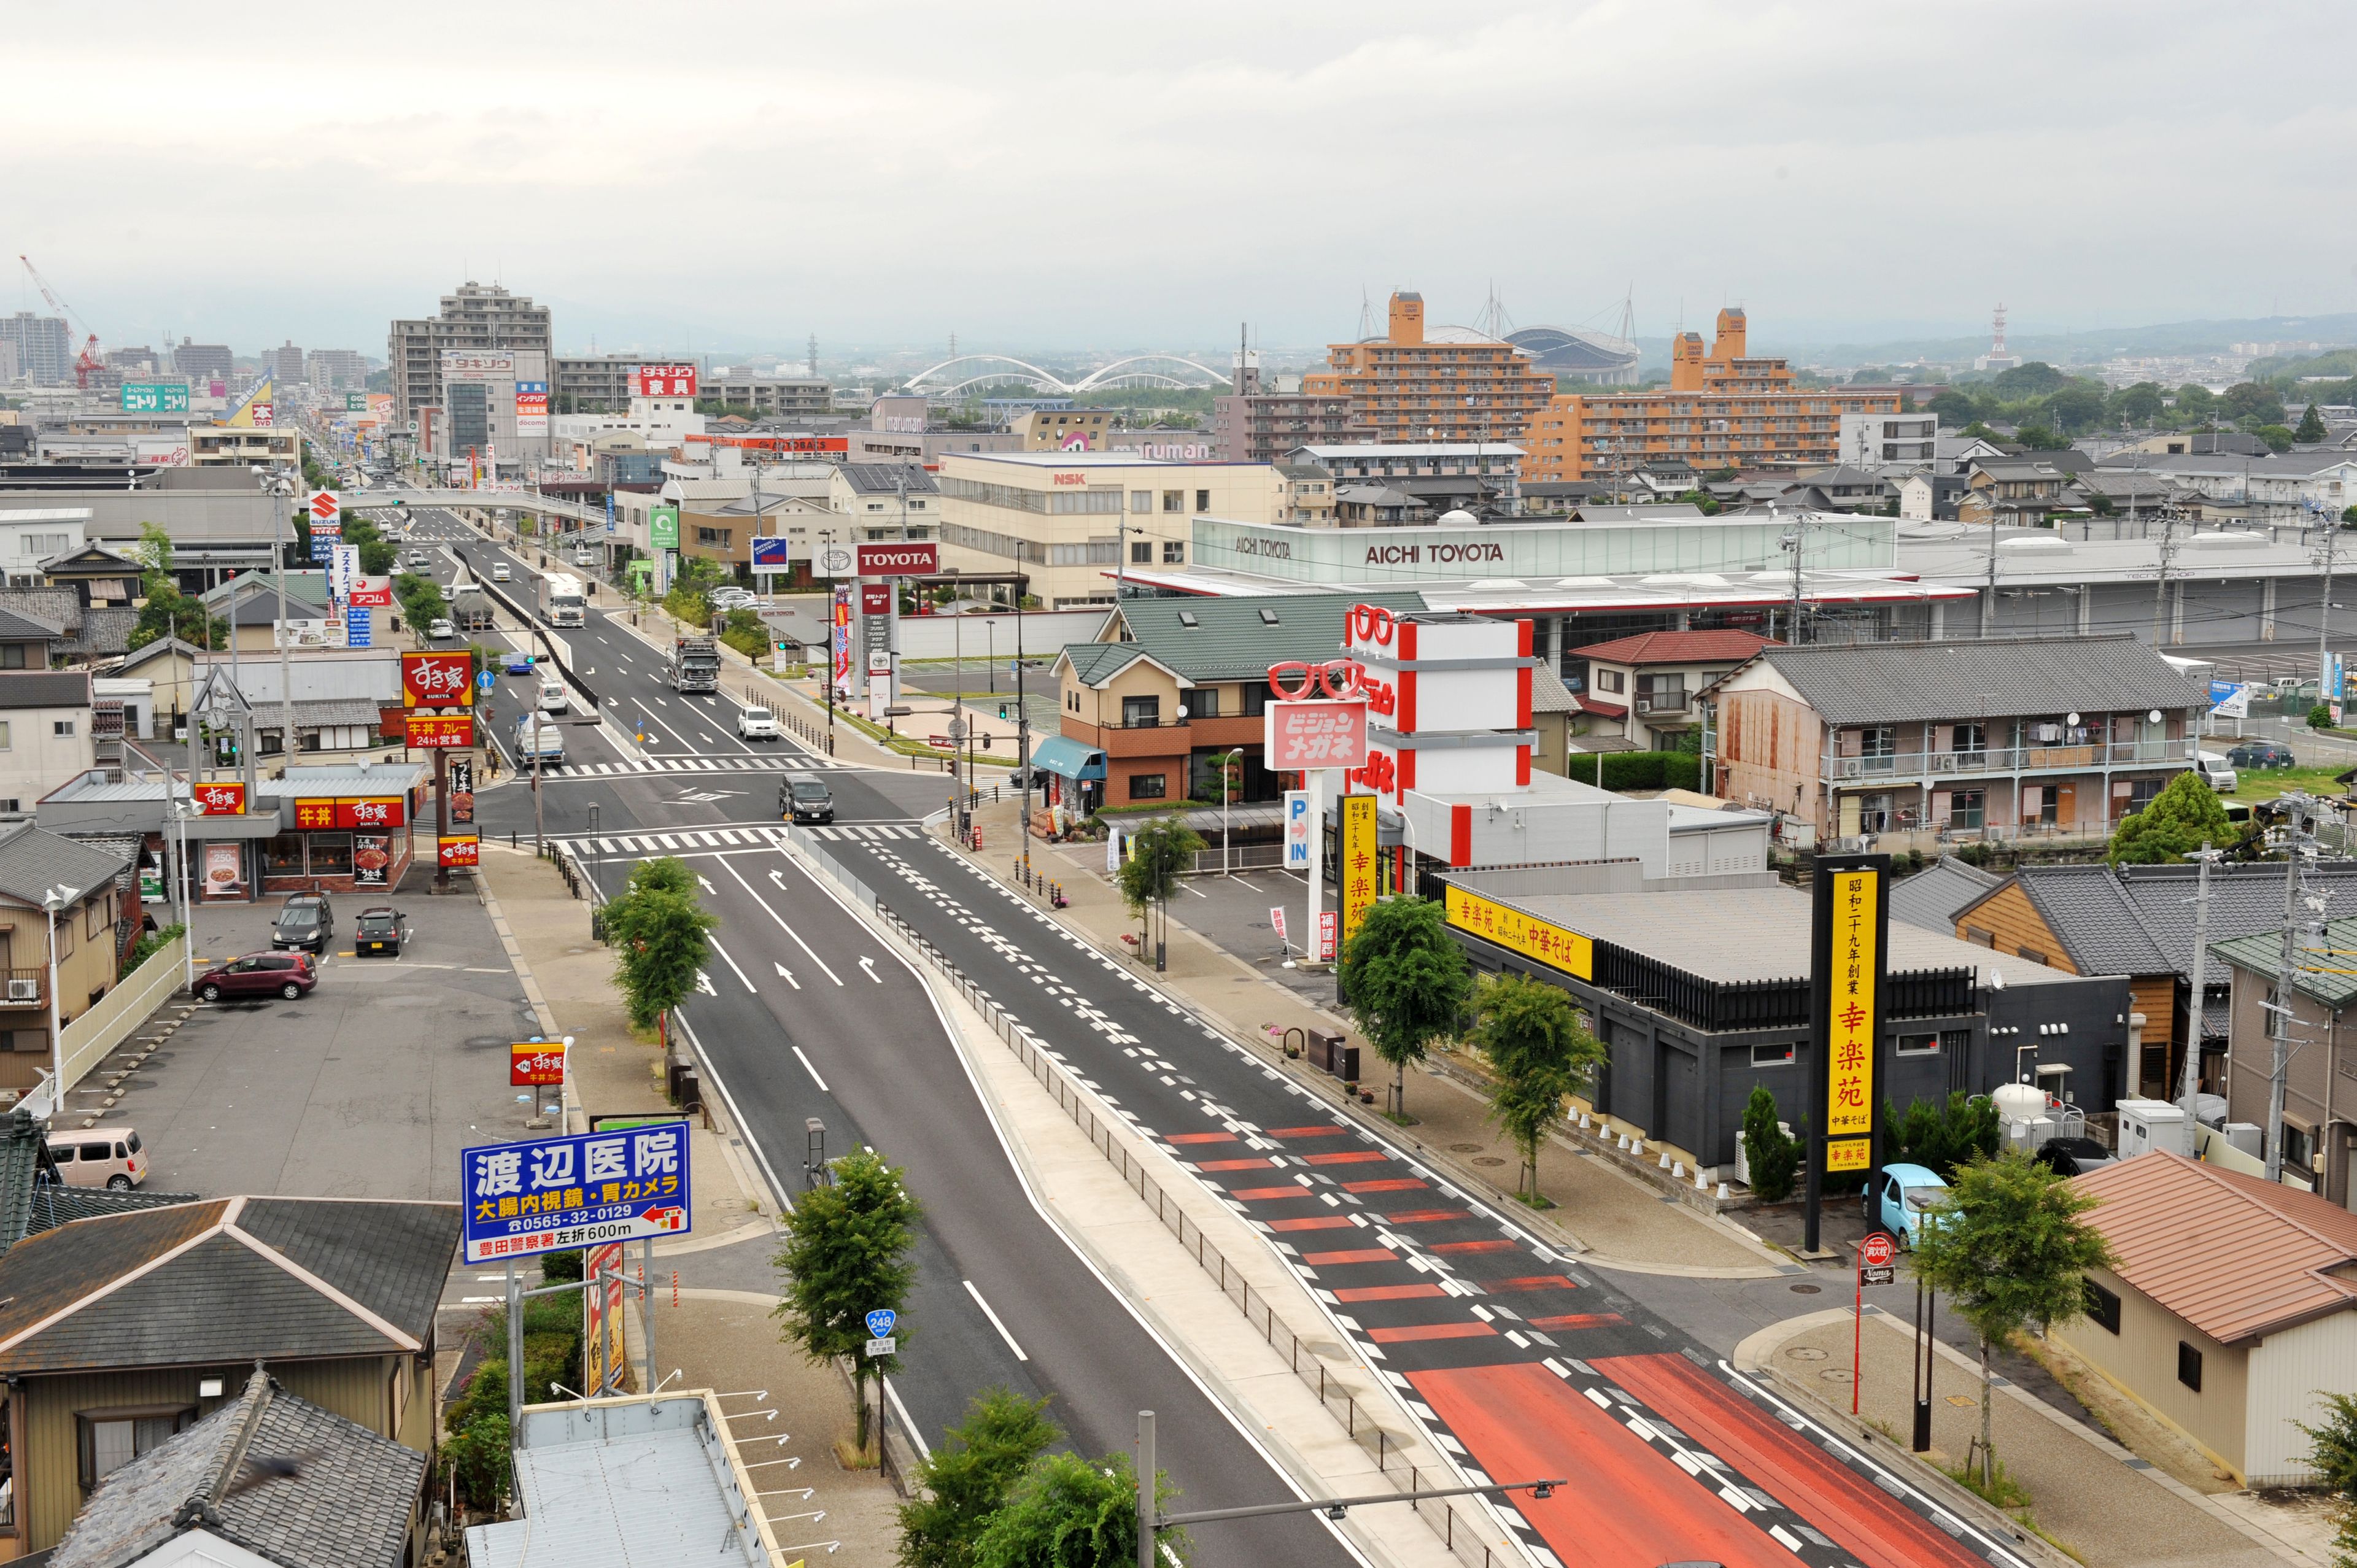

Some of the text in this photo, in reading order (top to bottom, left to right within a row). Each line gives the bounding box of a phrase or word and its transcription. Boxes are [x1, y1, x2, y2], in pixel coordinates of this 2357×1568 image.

[643, 367, 693, 377] タキソウ
[649, 379, 689, 395] 家具
[126, 395, 187, 409] ニトリ ニトリ
[253, 406, 272, 419] 本
[886, 414, 923, 433] maruman
[1054, 474, 1086, 485] NSK
[1236, 536, 1291, 560] AICHI TOYOTA
[1366, 544, 1503, 565] AICHI TOYOTA
[861, 553, 932, 566] TOYOTA
[356, 594, 384, 604] アコム
[411, 658, 465, 693] すき家
[409, 722, 469, 735] 牛丼 カレー
[1285, 713, 1354, 734] ビジョン
[1285, 735, 1354, 760] メガネ
[204, 787, 236, 806] すき家
[300, 807, 331, 825] 牛丼
[352, 798, 387, 822] すき家
[1292, 800, 1306, 820] P
[1351, 803, 1360, 851] 昭和二十九年
[453, 841, 476, 856] すき家
[1291, 843, 1306, 860] IN
[1461, 897, 1493, 933] 幸楽苑
[1321, 914, 1334, 955] 補聴器
[1498, 925, 1527, 947] 昭和二十九年
[1528, 923, 1574, 965] 中華そば
[1848, 878, 1862, 995] 昭和二十九年創業
[532, 1051, 562, 1072] すき家
[1836, 1001, 1867, 1108] 幸楽苑
[1831, 1113, 1868, 1128] 中華そば
[474, 1131, 678, 1197] 渡辺医院
[1831, 1148, 1865, 1162] 幸楽苑
[475, 1175, 678, 1220] 大腸内視鏡・胃カメラ
[523, 1205, 632, 1230] 0565-32-0129
[1867, 1246, 1888, 1257] 消火栓
[1864, 1269, 1892, 1278] Noma
[870, 1316, 891, 1329] 248
